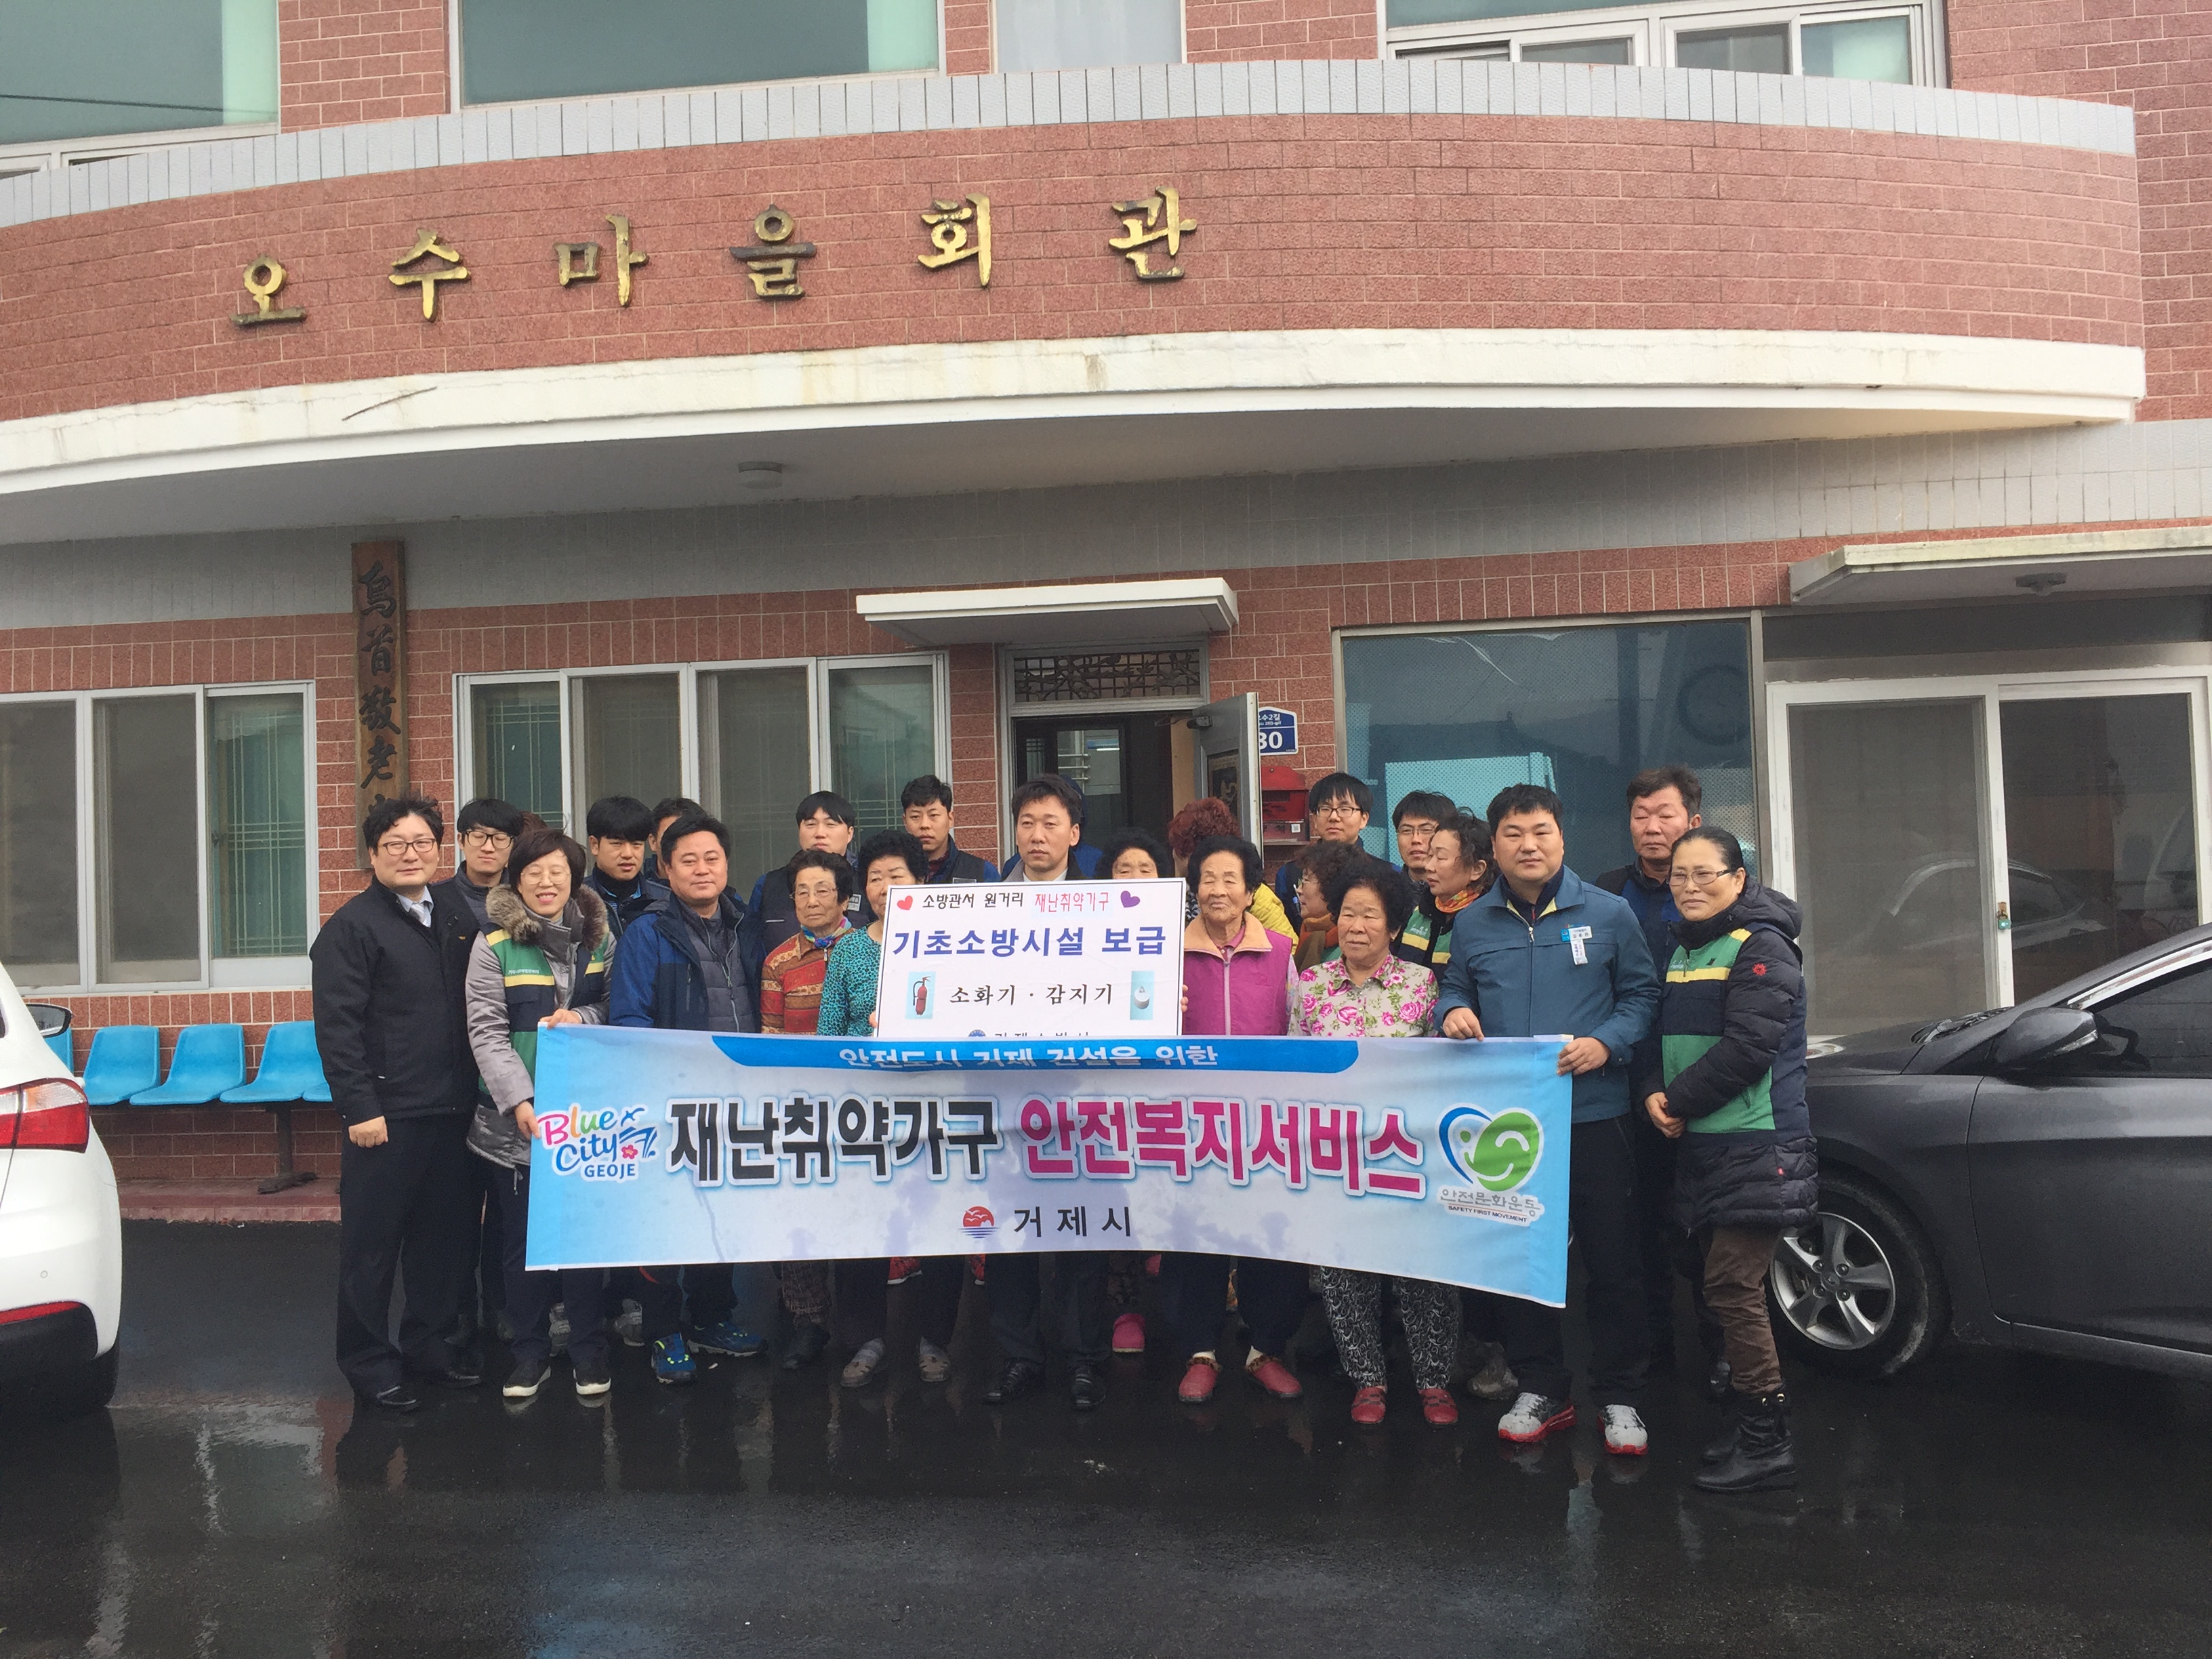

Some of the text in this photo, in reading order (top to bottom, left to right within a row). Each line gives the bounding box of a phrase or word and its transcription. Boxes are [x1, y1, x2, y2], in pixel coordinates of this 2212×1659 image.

[229, 184, 1198, 327] 오수마을회관
[922, 892, 1109, 913] 소방관서 원거리 재난취약가구
[893, 926, 1166, 959] 기초소방시설 보급
[950, 983, 1113, 1006] 소화기 감지기
[537, 1106, 618, 1146] Blue
[556, 1133, 617, 1172] City
[670, 1095, 1421, 1194] 재난취약가구 안전복지서비스
[584, 1163, 636, 1179] GEOJE
[1440, 1189, 1540, 1217] 안전문화운동
[1448, 1206, 1473, 1214] SAFETY
[1492, 1212, 1528, 1223] MOVEMENT
[1014, 1206, 1131, 1238] 거제시
